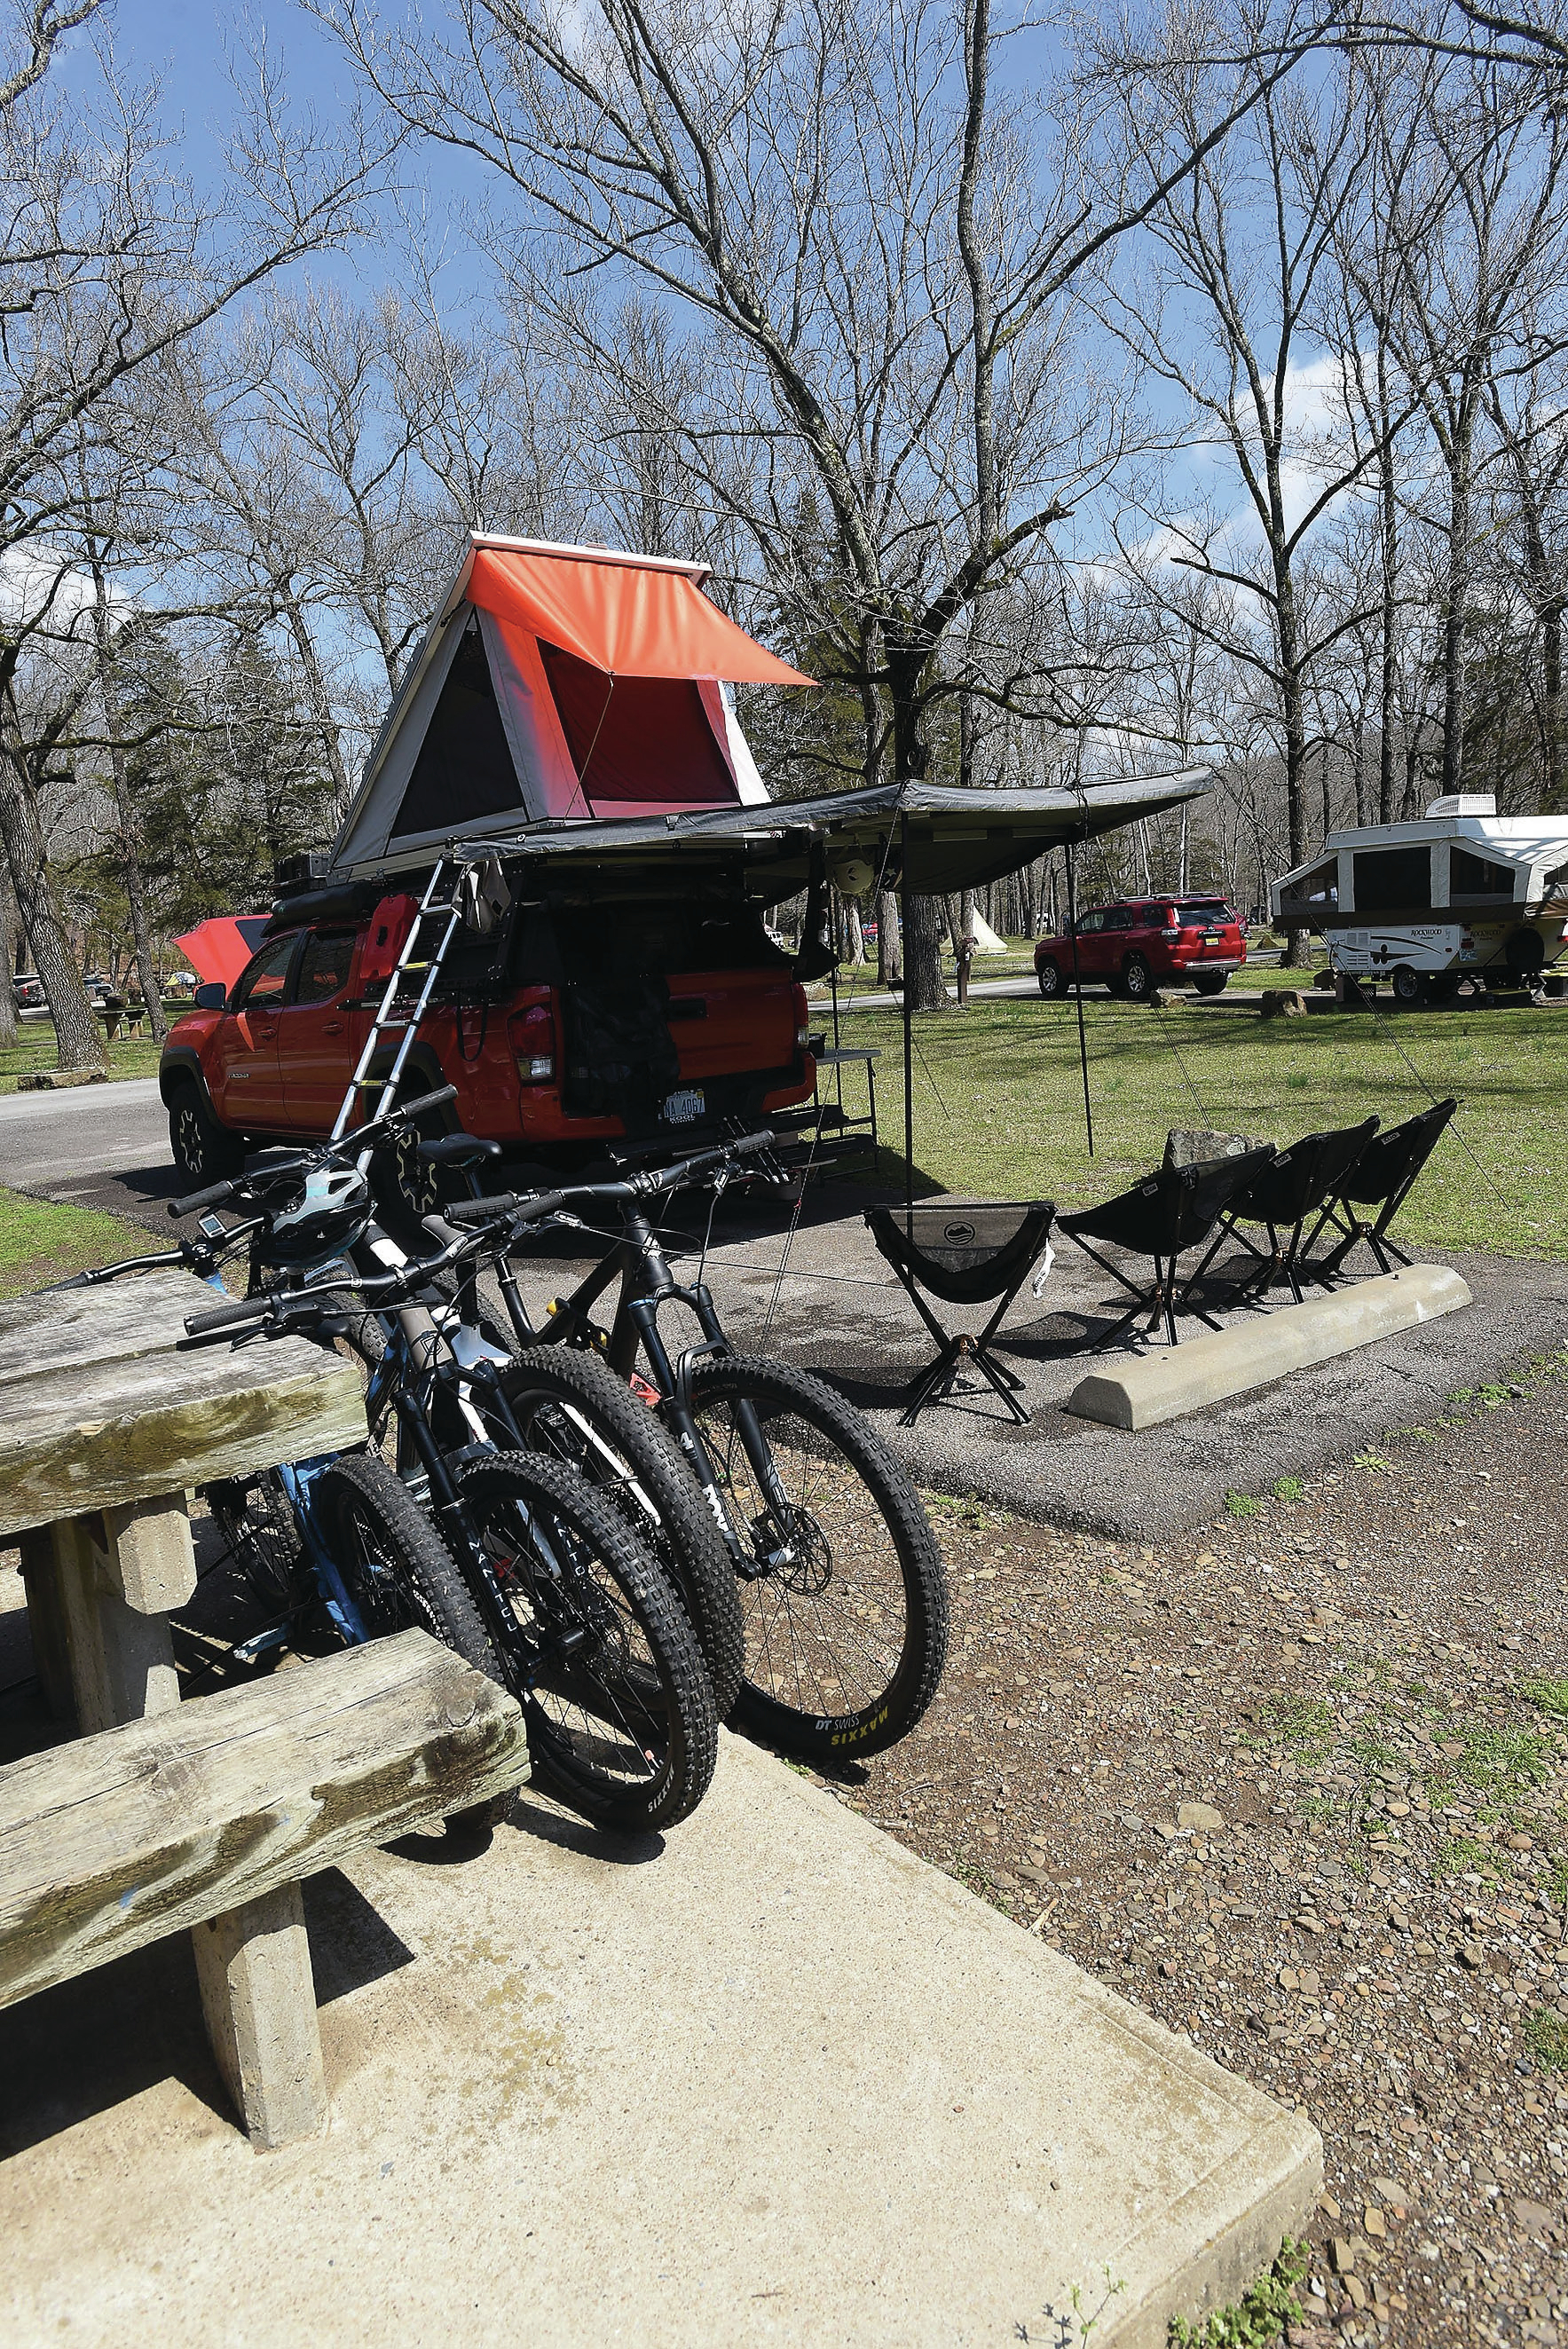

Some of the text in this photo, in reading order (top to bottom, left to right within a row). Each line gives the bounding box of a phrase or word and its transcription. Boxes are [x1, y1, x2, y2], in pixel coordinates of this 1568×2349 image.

[682, 1098, 703, 1115] 4067
[468, 1537, 518, 1632] MANITOU
[815, 1713, 860, 1731] DT SWISS
[831, 1705, 888, 1746] MAXXIS
